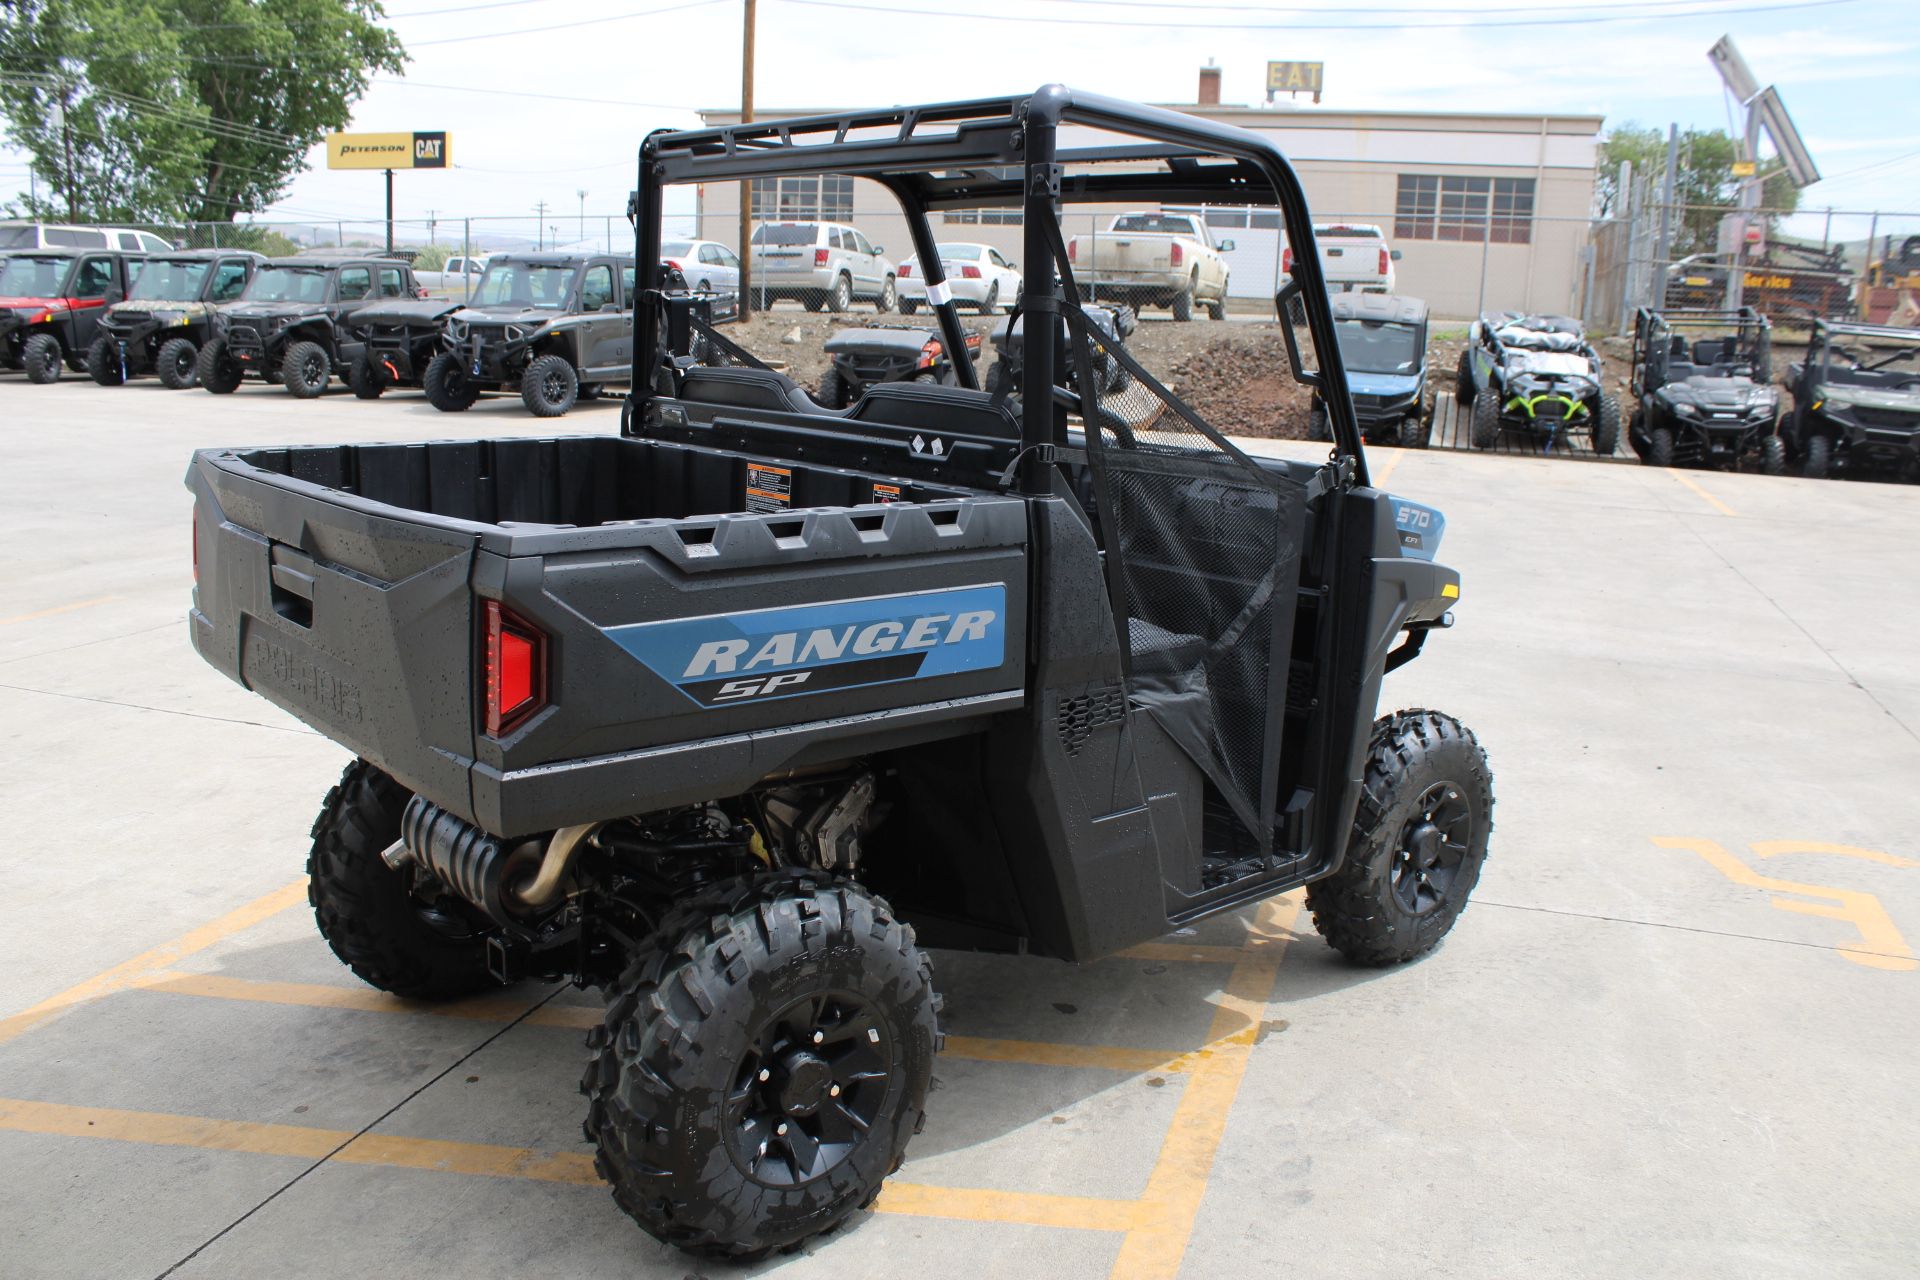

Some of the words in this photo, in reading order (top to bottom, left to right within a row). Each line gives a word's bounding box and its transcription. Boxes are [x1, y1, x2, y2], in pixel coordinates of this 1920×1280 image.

[1269, 63, 1321, 88] EAT
[341, 145, 406, 156] PETERSON
[415, 139, 442, 159] CAT
[1396, 506, 1431, 528] 570
[682, 610, 996, 678] RANGER
[712, 671, 813, 701] SP
